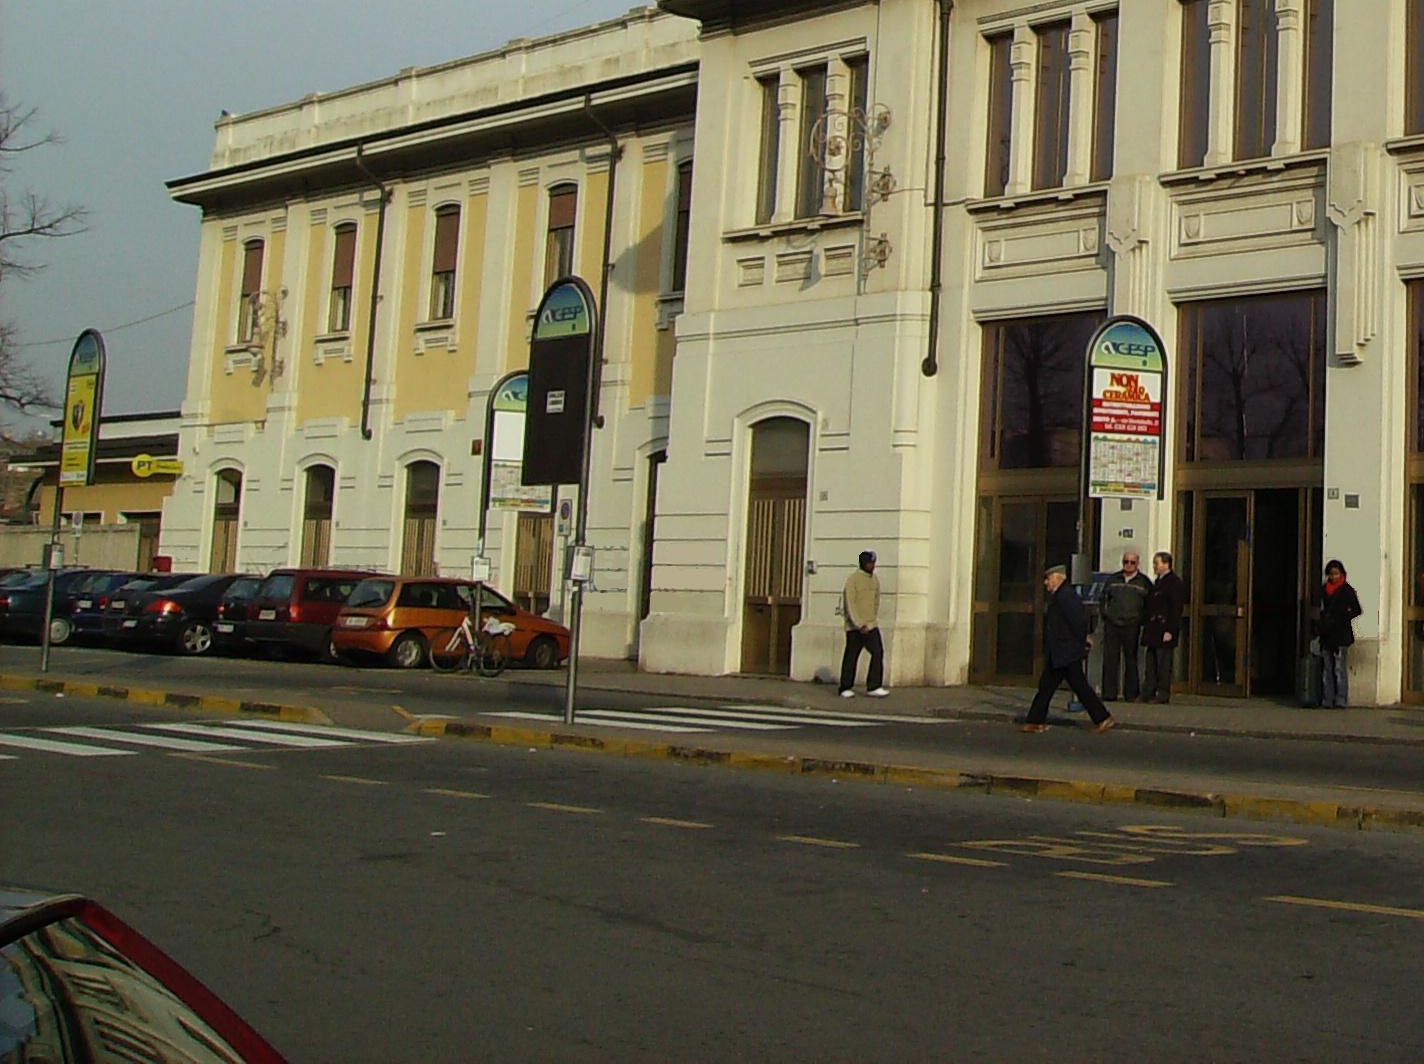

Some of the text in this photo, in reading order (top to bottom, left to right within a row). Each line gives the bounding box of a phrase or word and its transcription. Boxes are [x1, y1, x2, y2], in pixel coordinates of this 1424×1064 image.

[1110, 372, 1139, 388] NON
[137, 460, 152, 471] PT
[947, 824, 1309, 865] BUS
